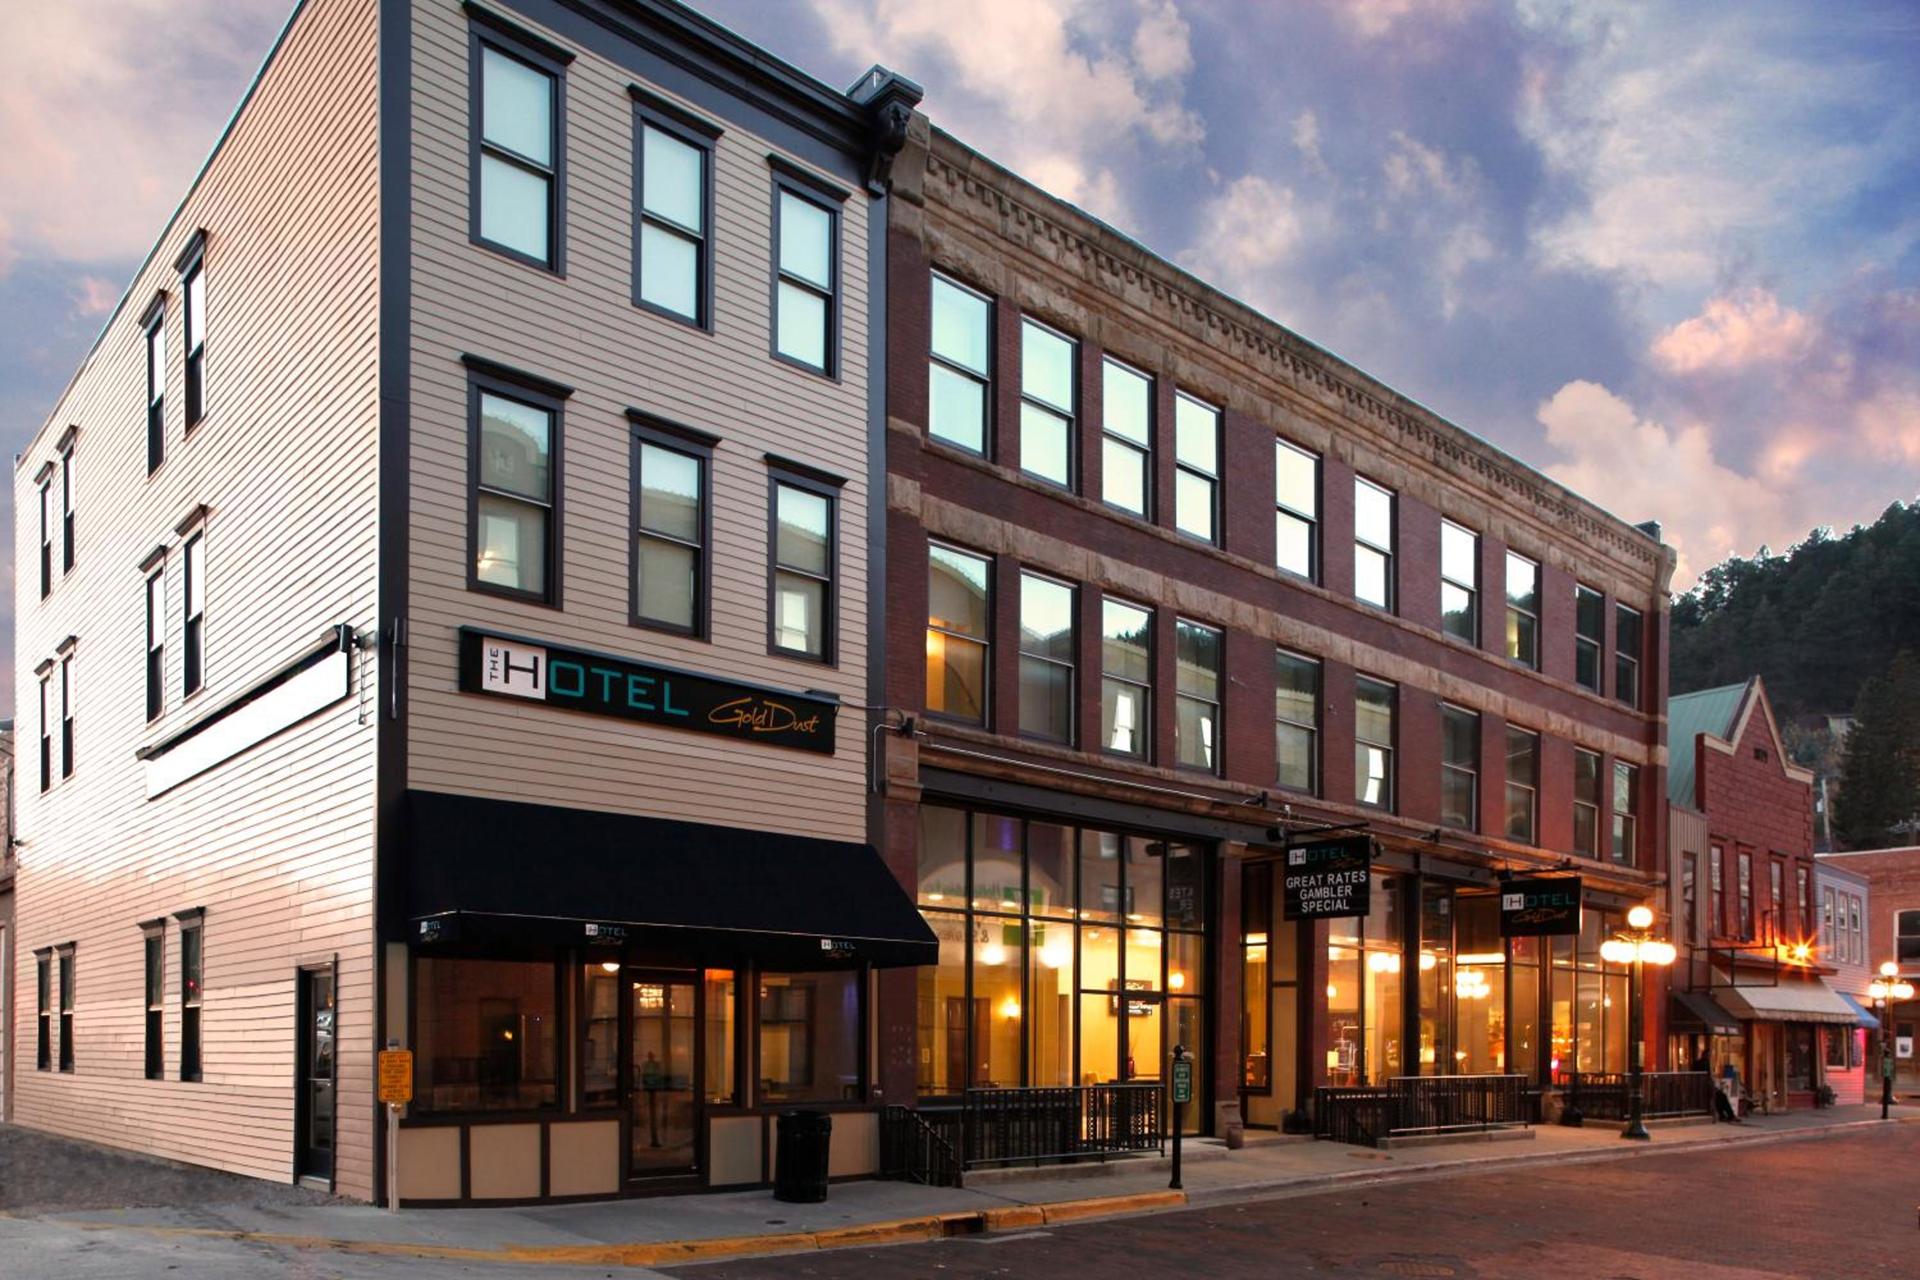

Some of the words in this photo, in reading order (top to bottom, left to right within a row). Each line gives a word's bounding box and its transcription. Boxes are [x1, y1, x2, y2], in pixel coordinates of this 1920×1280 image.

[489, 647, 499, 682] THE
[503, 650, 690, 717] HOTEL
[1292, 847, 1348, 864] HOTEL
[1286, 874, 1323, 889] GREAT
[1327, 870, 1367, 885] RATES
[1299, 885, 1353, 901] GAMBLER
[1509, 891, 1577, 908] HOTEL
[1301, 898, 1350, 913] SPECIAL
